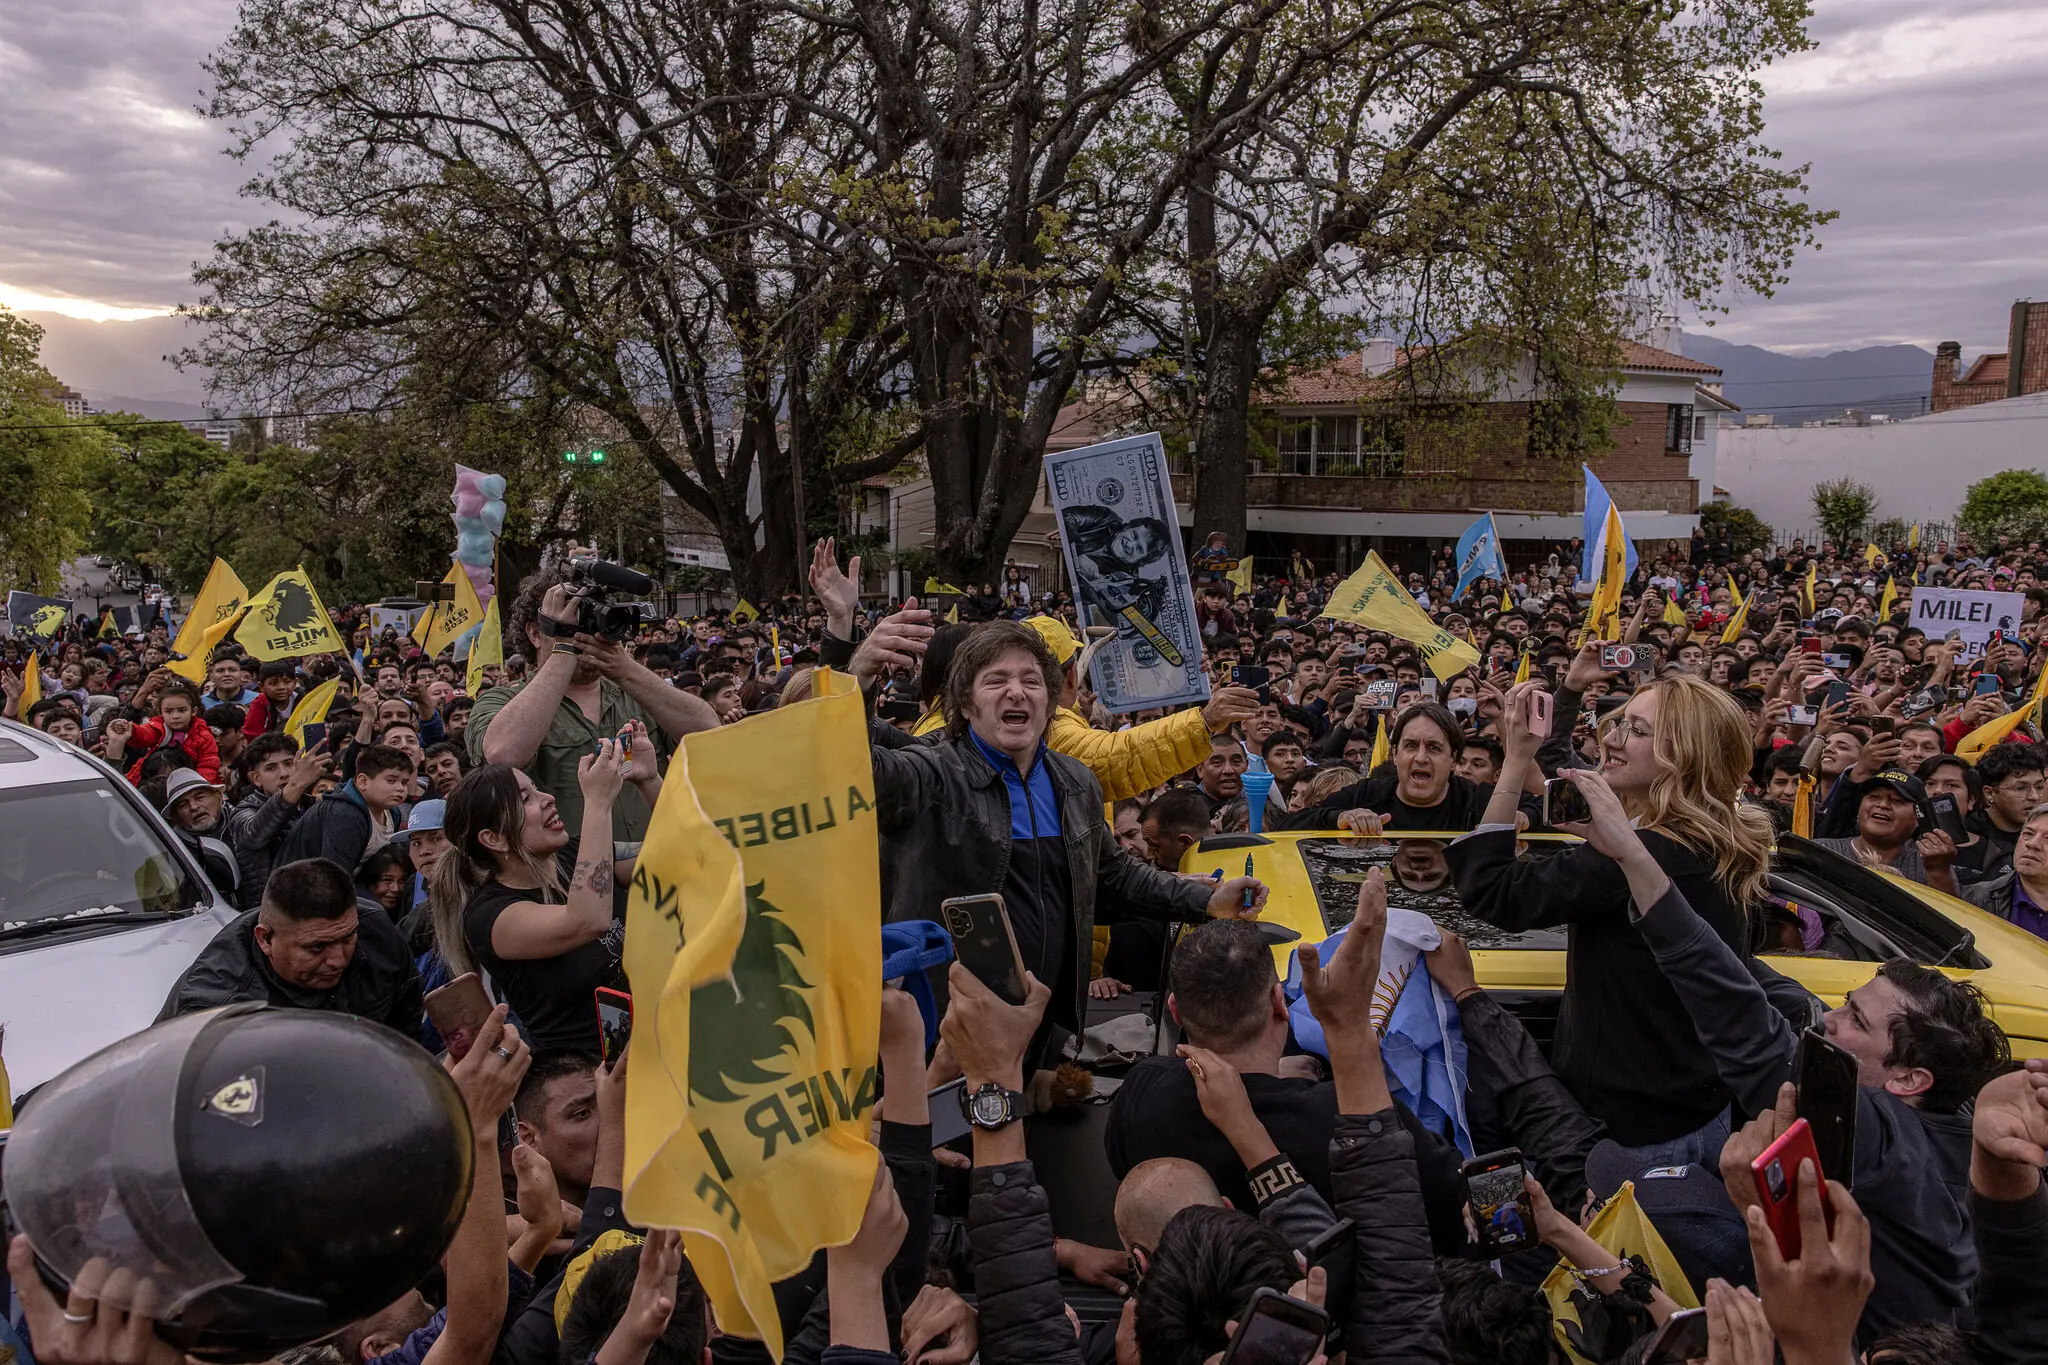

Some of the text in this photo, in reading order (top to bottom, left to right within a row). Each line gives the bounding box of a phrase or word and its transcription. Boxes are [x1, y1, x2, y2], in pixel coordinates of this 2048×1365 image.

[1142, 446, 1158, 482] 100
[1918, 598, 1993, 623] MILEI
[445, 615, 468, 634] 2023
[1886, 774, 1908, 783] MILEI
